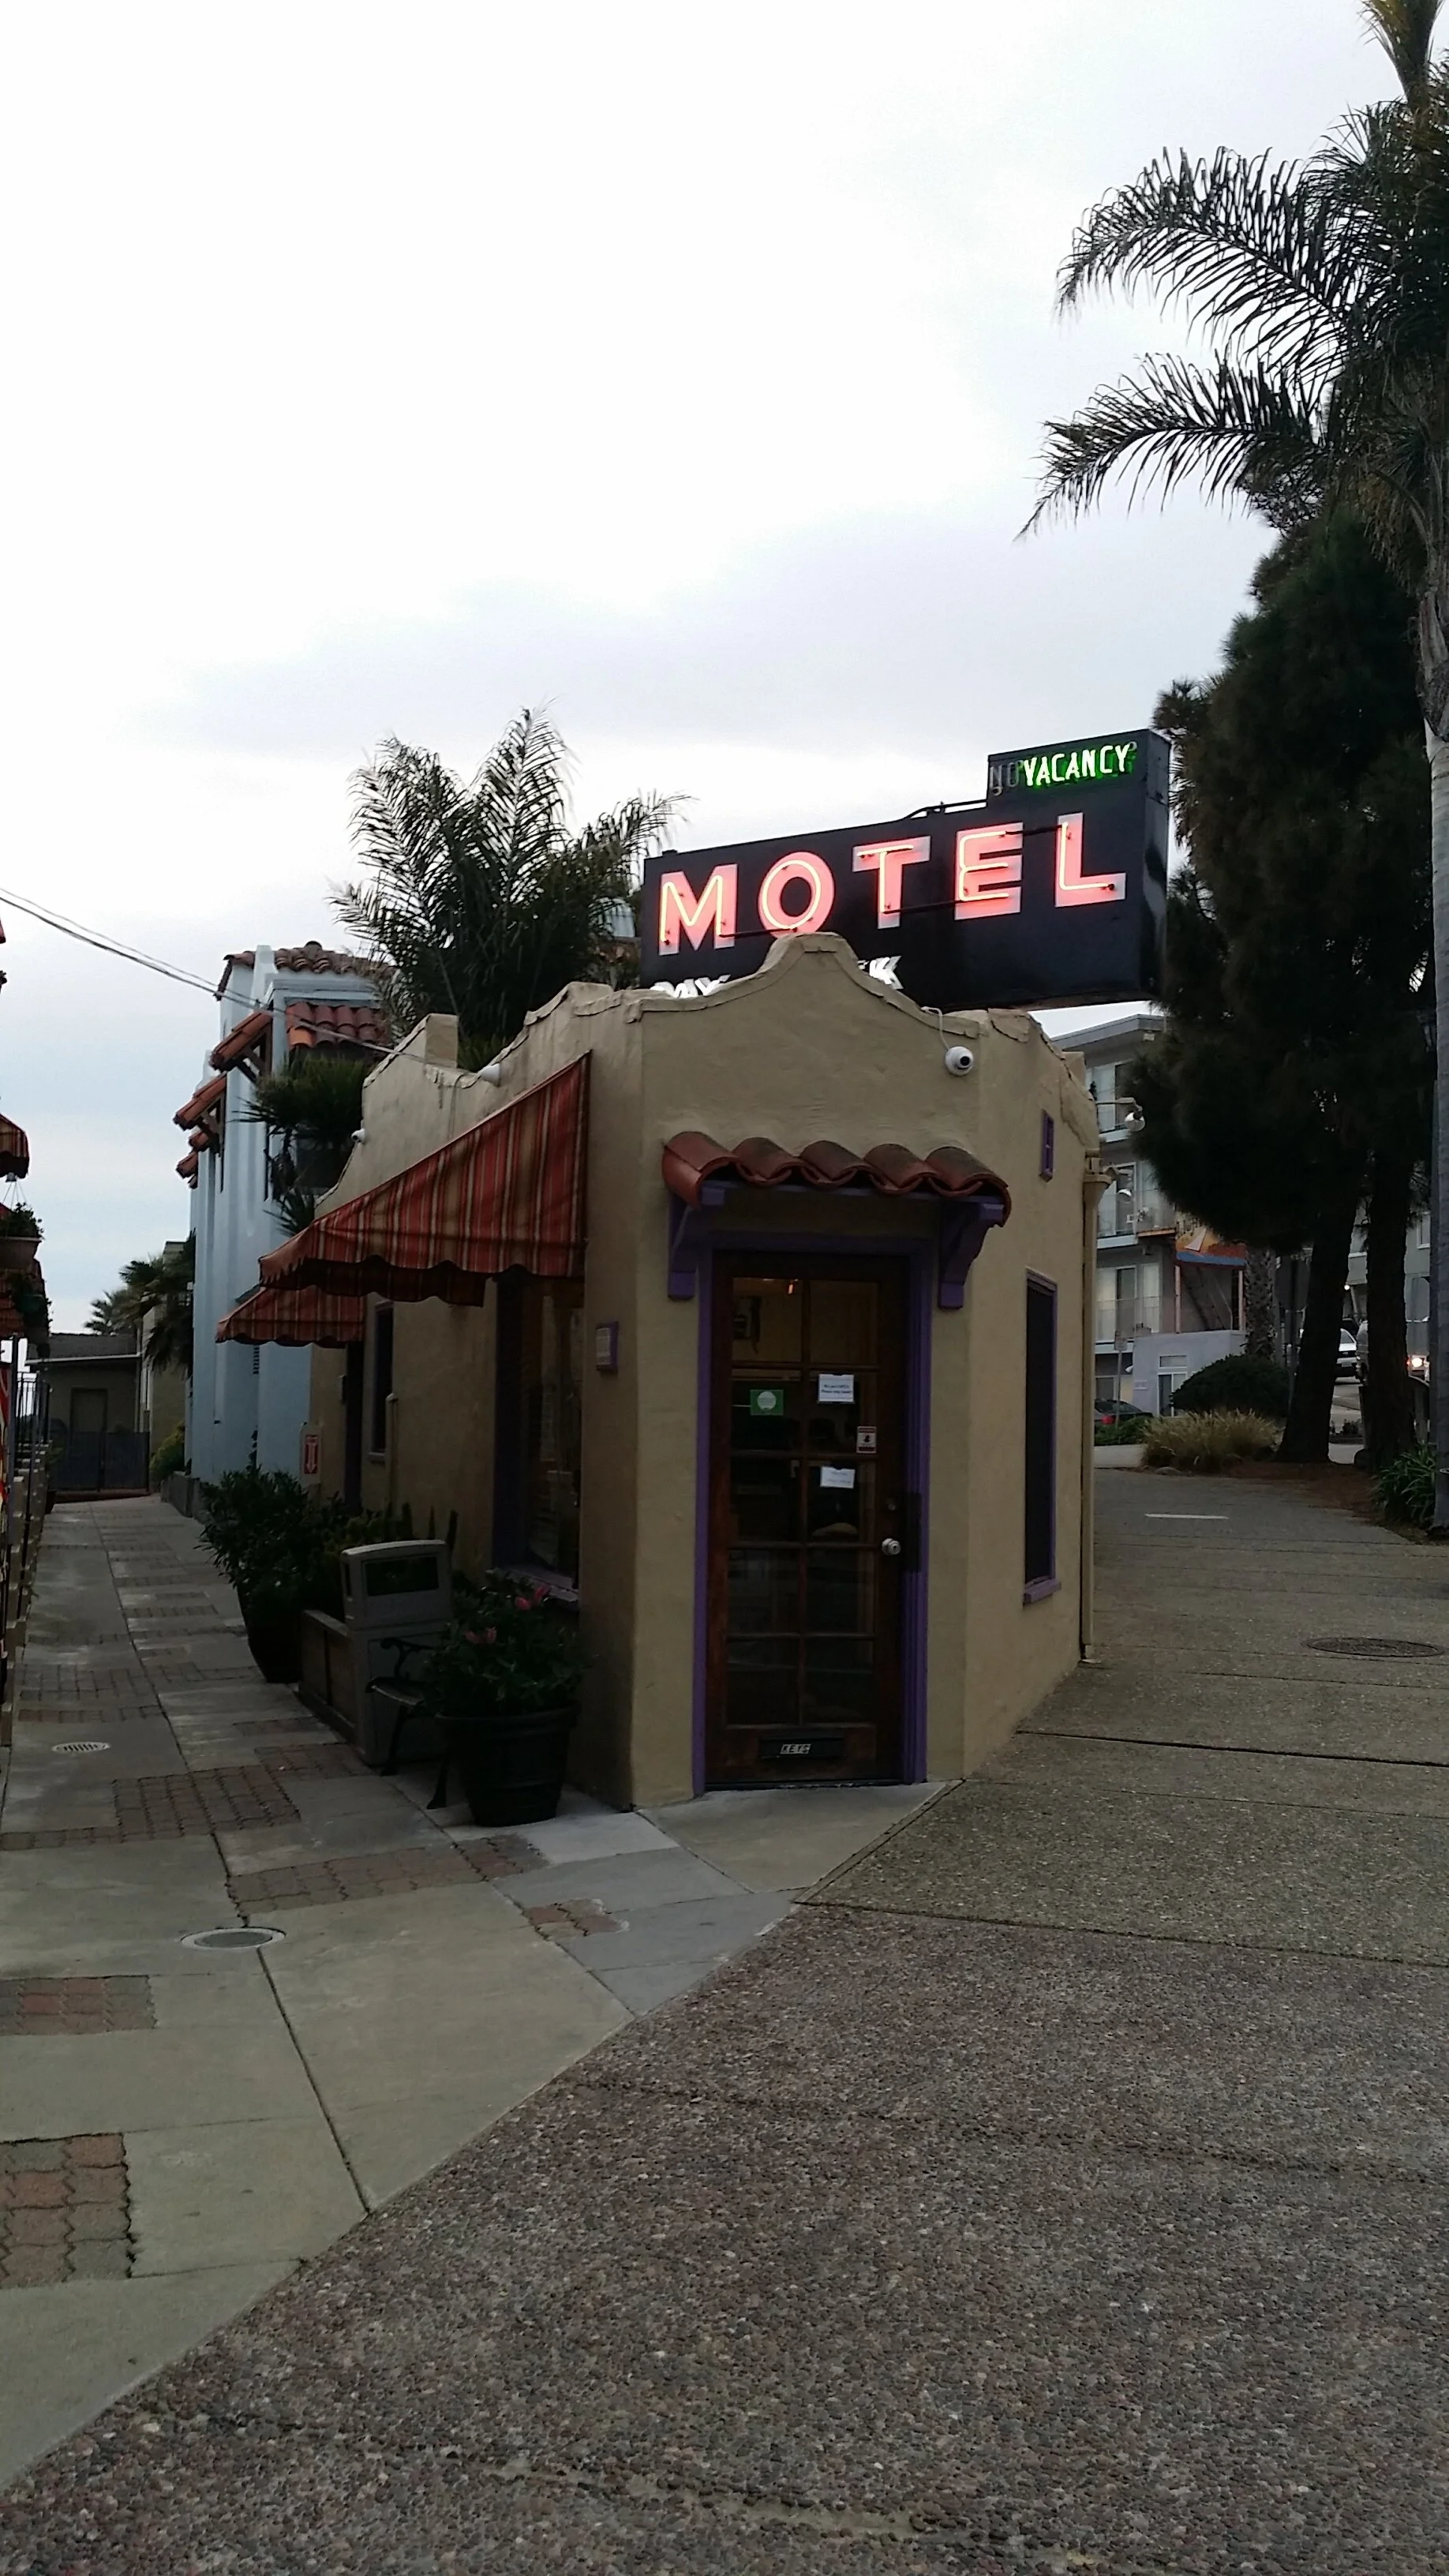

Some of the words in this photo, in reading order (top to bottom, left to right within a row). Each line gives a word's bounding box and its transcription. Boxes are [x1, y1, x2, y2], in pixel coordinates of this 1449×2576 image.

[1023, 743, 1132, 788] VACANCY
[658, 812, 1126, 956] MOTEL
[780, 1743, 811, 1754] KEYS
